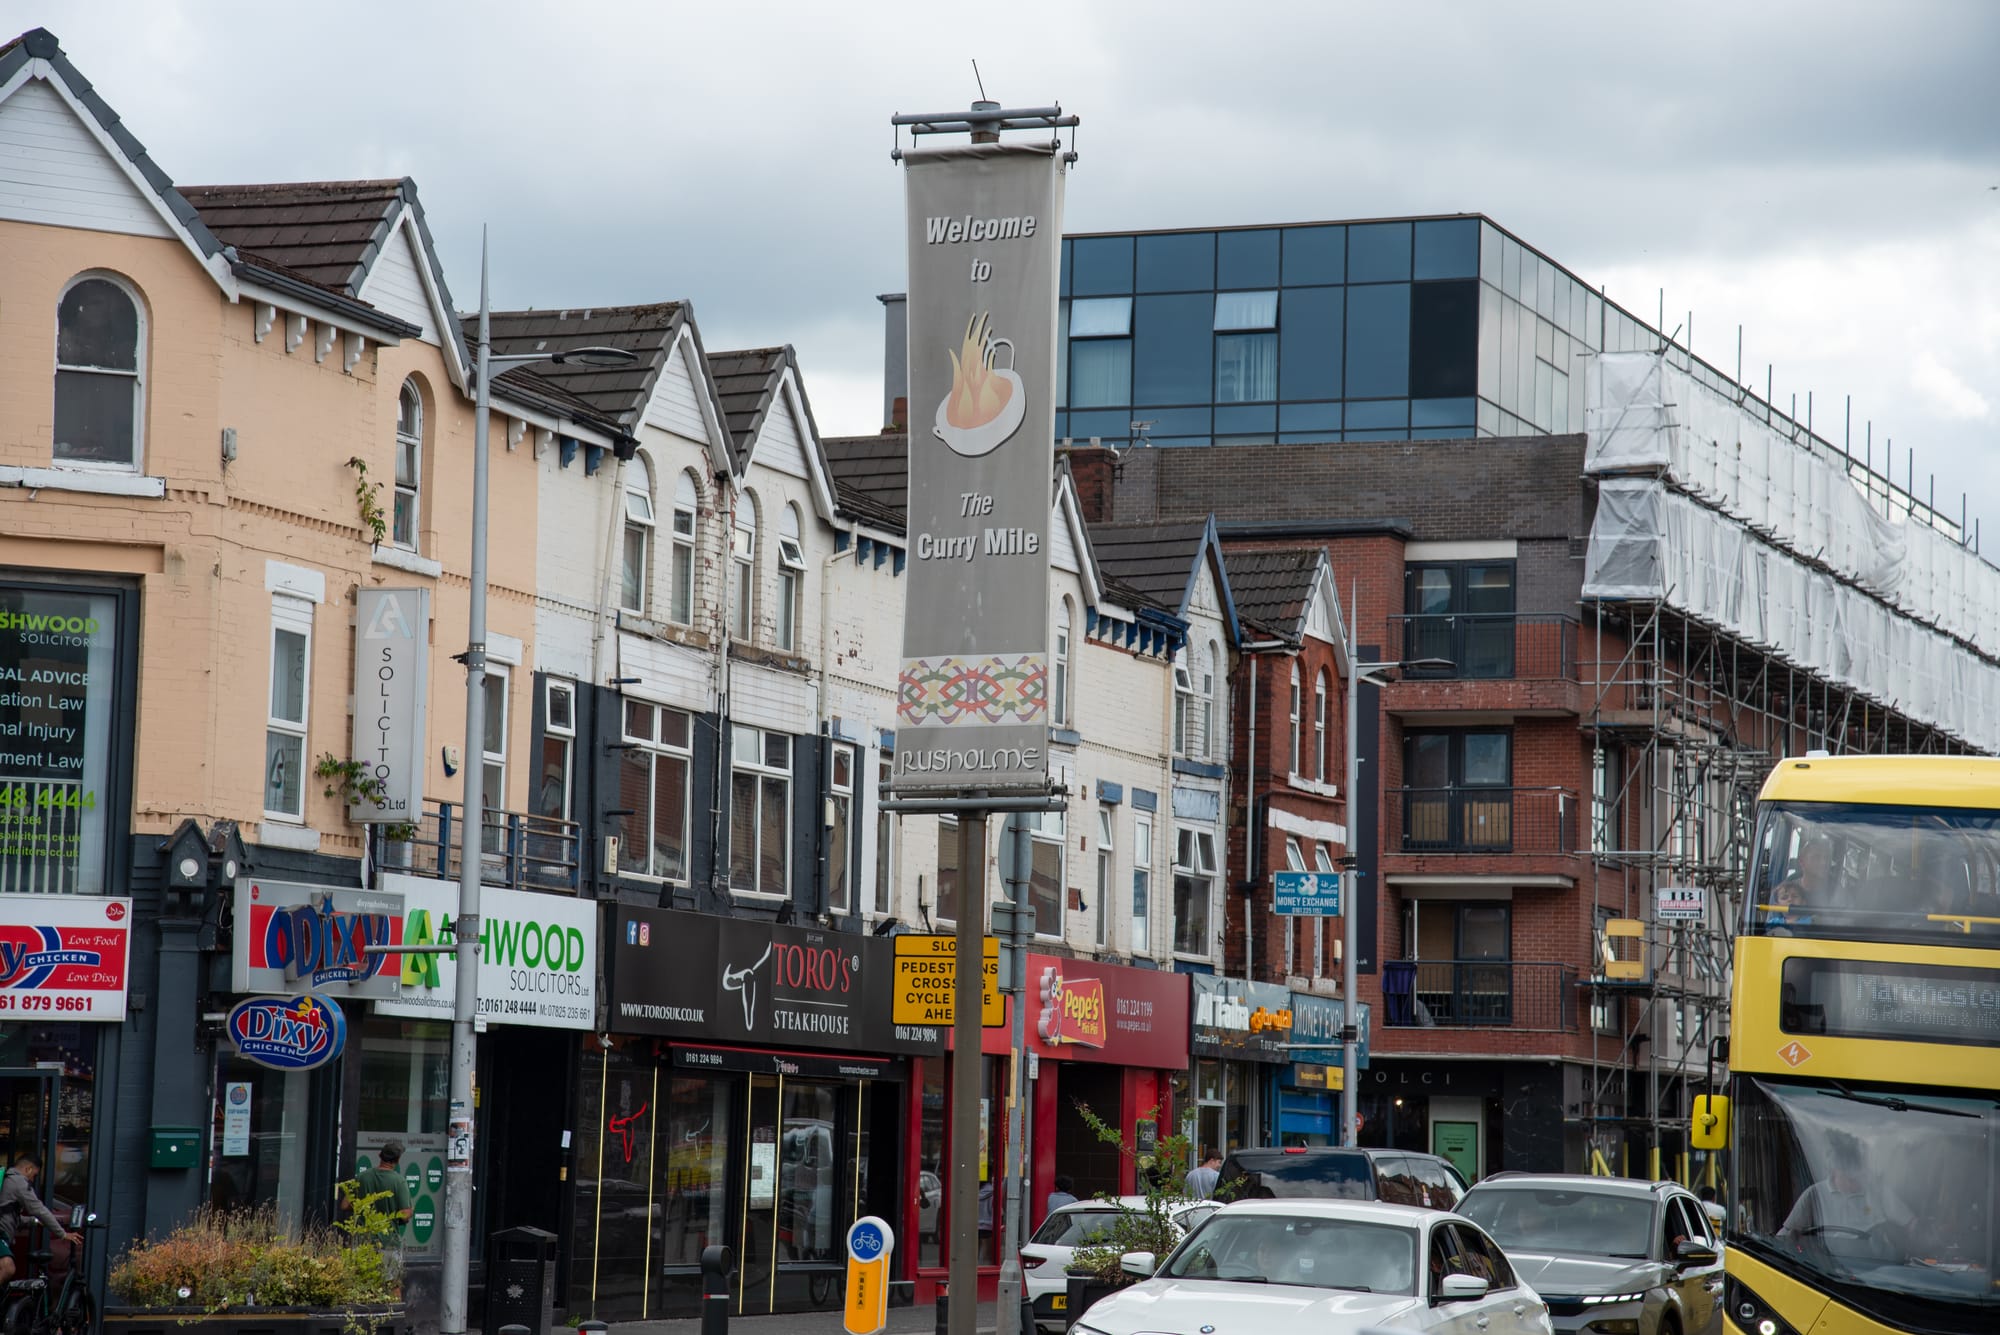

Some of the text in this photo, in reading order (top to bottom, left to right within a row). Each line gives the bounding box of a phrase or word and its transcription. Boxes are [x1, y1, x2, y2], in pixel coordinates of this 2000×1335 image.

[926, 215, 1037, 245] Welcome
[971, 258, 992, 282] to
[961, 492, 993, 517] The
[917, 527, 1040, 562] Curry Mile
[31, 669, 89, 686] ADVICE
[48, 693, 84, 710] Law
[28, 721, 76, 743] Injury
[48, 752, 83, 769] Law
[901, 747, 1041, 776] RUSHOLME
[35, 788, 96, 812] 4444
[389, 799, 406, 810] Ltd
[1277, 896, 1338, 907] MONEY EXCHANGE
[68, 934, 120, 946] Love Food
[290, 904, 386, 982] Dixy
[437, 913, 584, 972] AHWOOD
[932, 941, 957, 952] SLO
[28, 953, 88, 966] CHICKEN
[902, 962, 998, 974] PEDESTNS
[66, 972, 118, 988] Love Dixy
[315, 970, 348, 982] CHICKEN
[510, 969, 581, 996] SOLICITORS
[21, 995, 51, 1011] 879
[55, 996, 92, 1011] 9661
[485, 998, 503, 1013] 0161
[505, 999, 518, 1014] 248
[519, 1001, 537, 1015] 4444
[906, 993, 950, 1005] CYCLE
[1116, 997, 1129, 1014] 0161
[1130, 998, 1140, 1016] 224
[620, 1002, 705, 1023] WWW.TOROSUK.CO.UK
[925, 1009, 956, 1020] AHE
[1064, 988, 1099, 1028] Pepe's
[248, 1005, 326, 1056] Dixy
[774, 1009, 849, 1035] STEAKHOUSE
[1294, 1002, 1323, 1038] MONEY
[1324, 1006, 1364, 1043] EXCHGE
[895, 1025, 910, 1040] 0161
[911, 1026, 922, 1041] 224
[243, 1042, 299, 1056] CHICKEN
